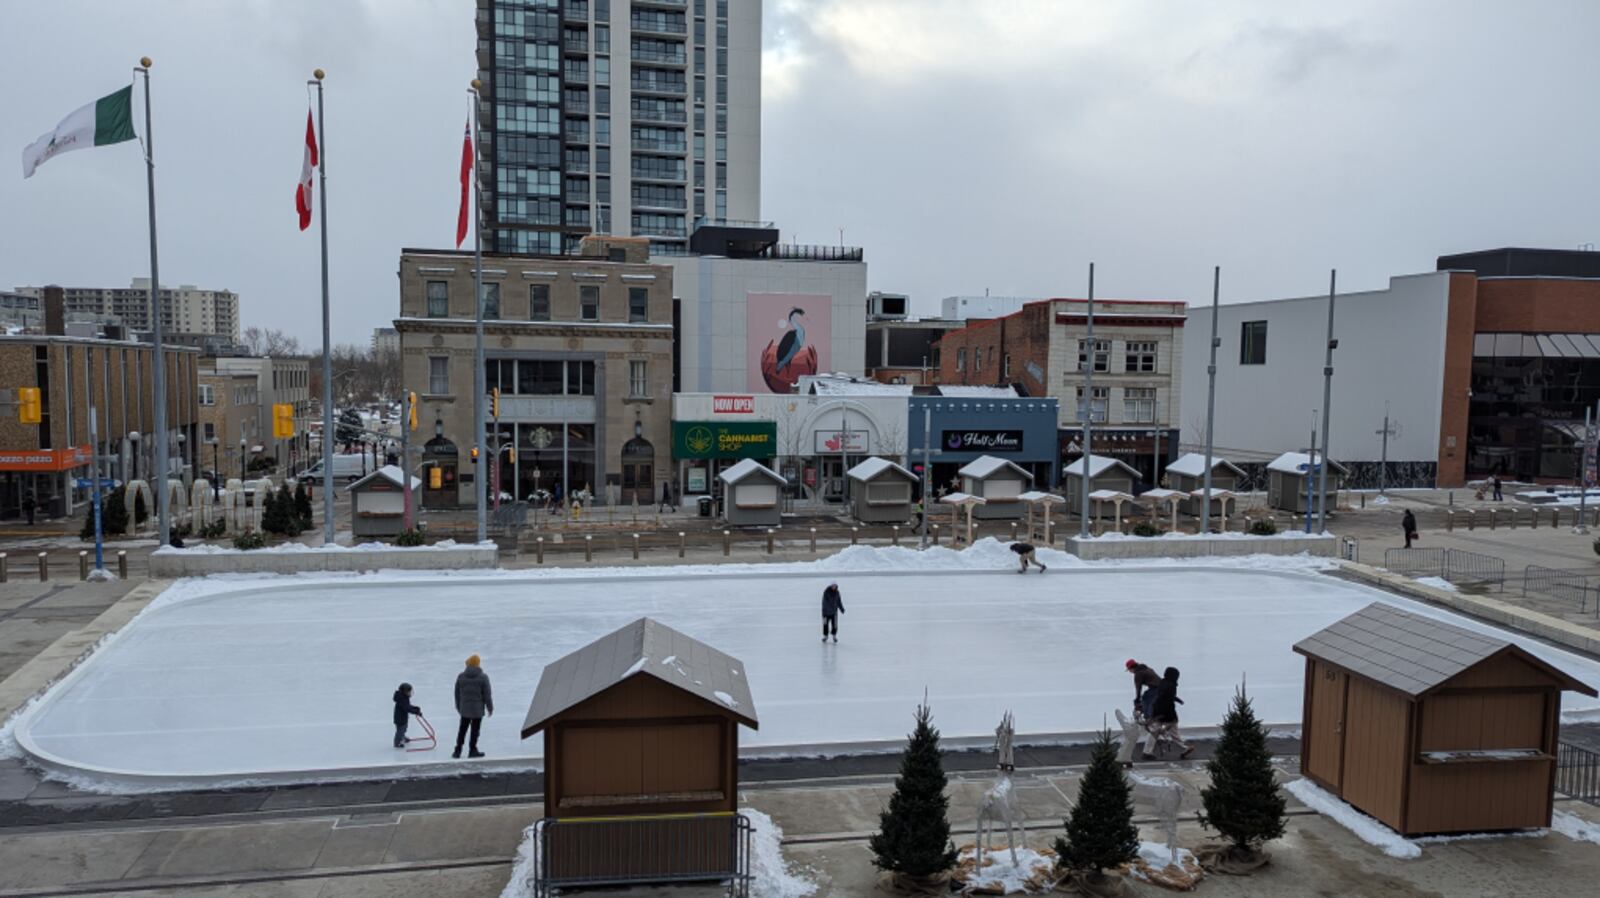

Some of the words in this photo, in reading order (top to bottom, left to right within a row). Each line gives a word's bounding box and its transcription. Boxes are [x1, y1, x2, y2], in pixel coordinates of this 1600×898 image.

[715, 398, 733, 411] NOW
[734, 398, 753, 411] OPEN
[719, 434, 768, 443] CANNABIST
[963, 432, 990, 446] Half
[988, 432, 1019, 446] Moon
[719, 443, 742, 451] SHOP
[26, 456, 52, 464] pizza
